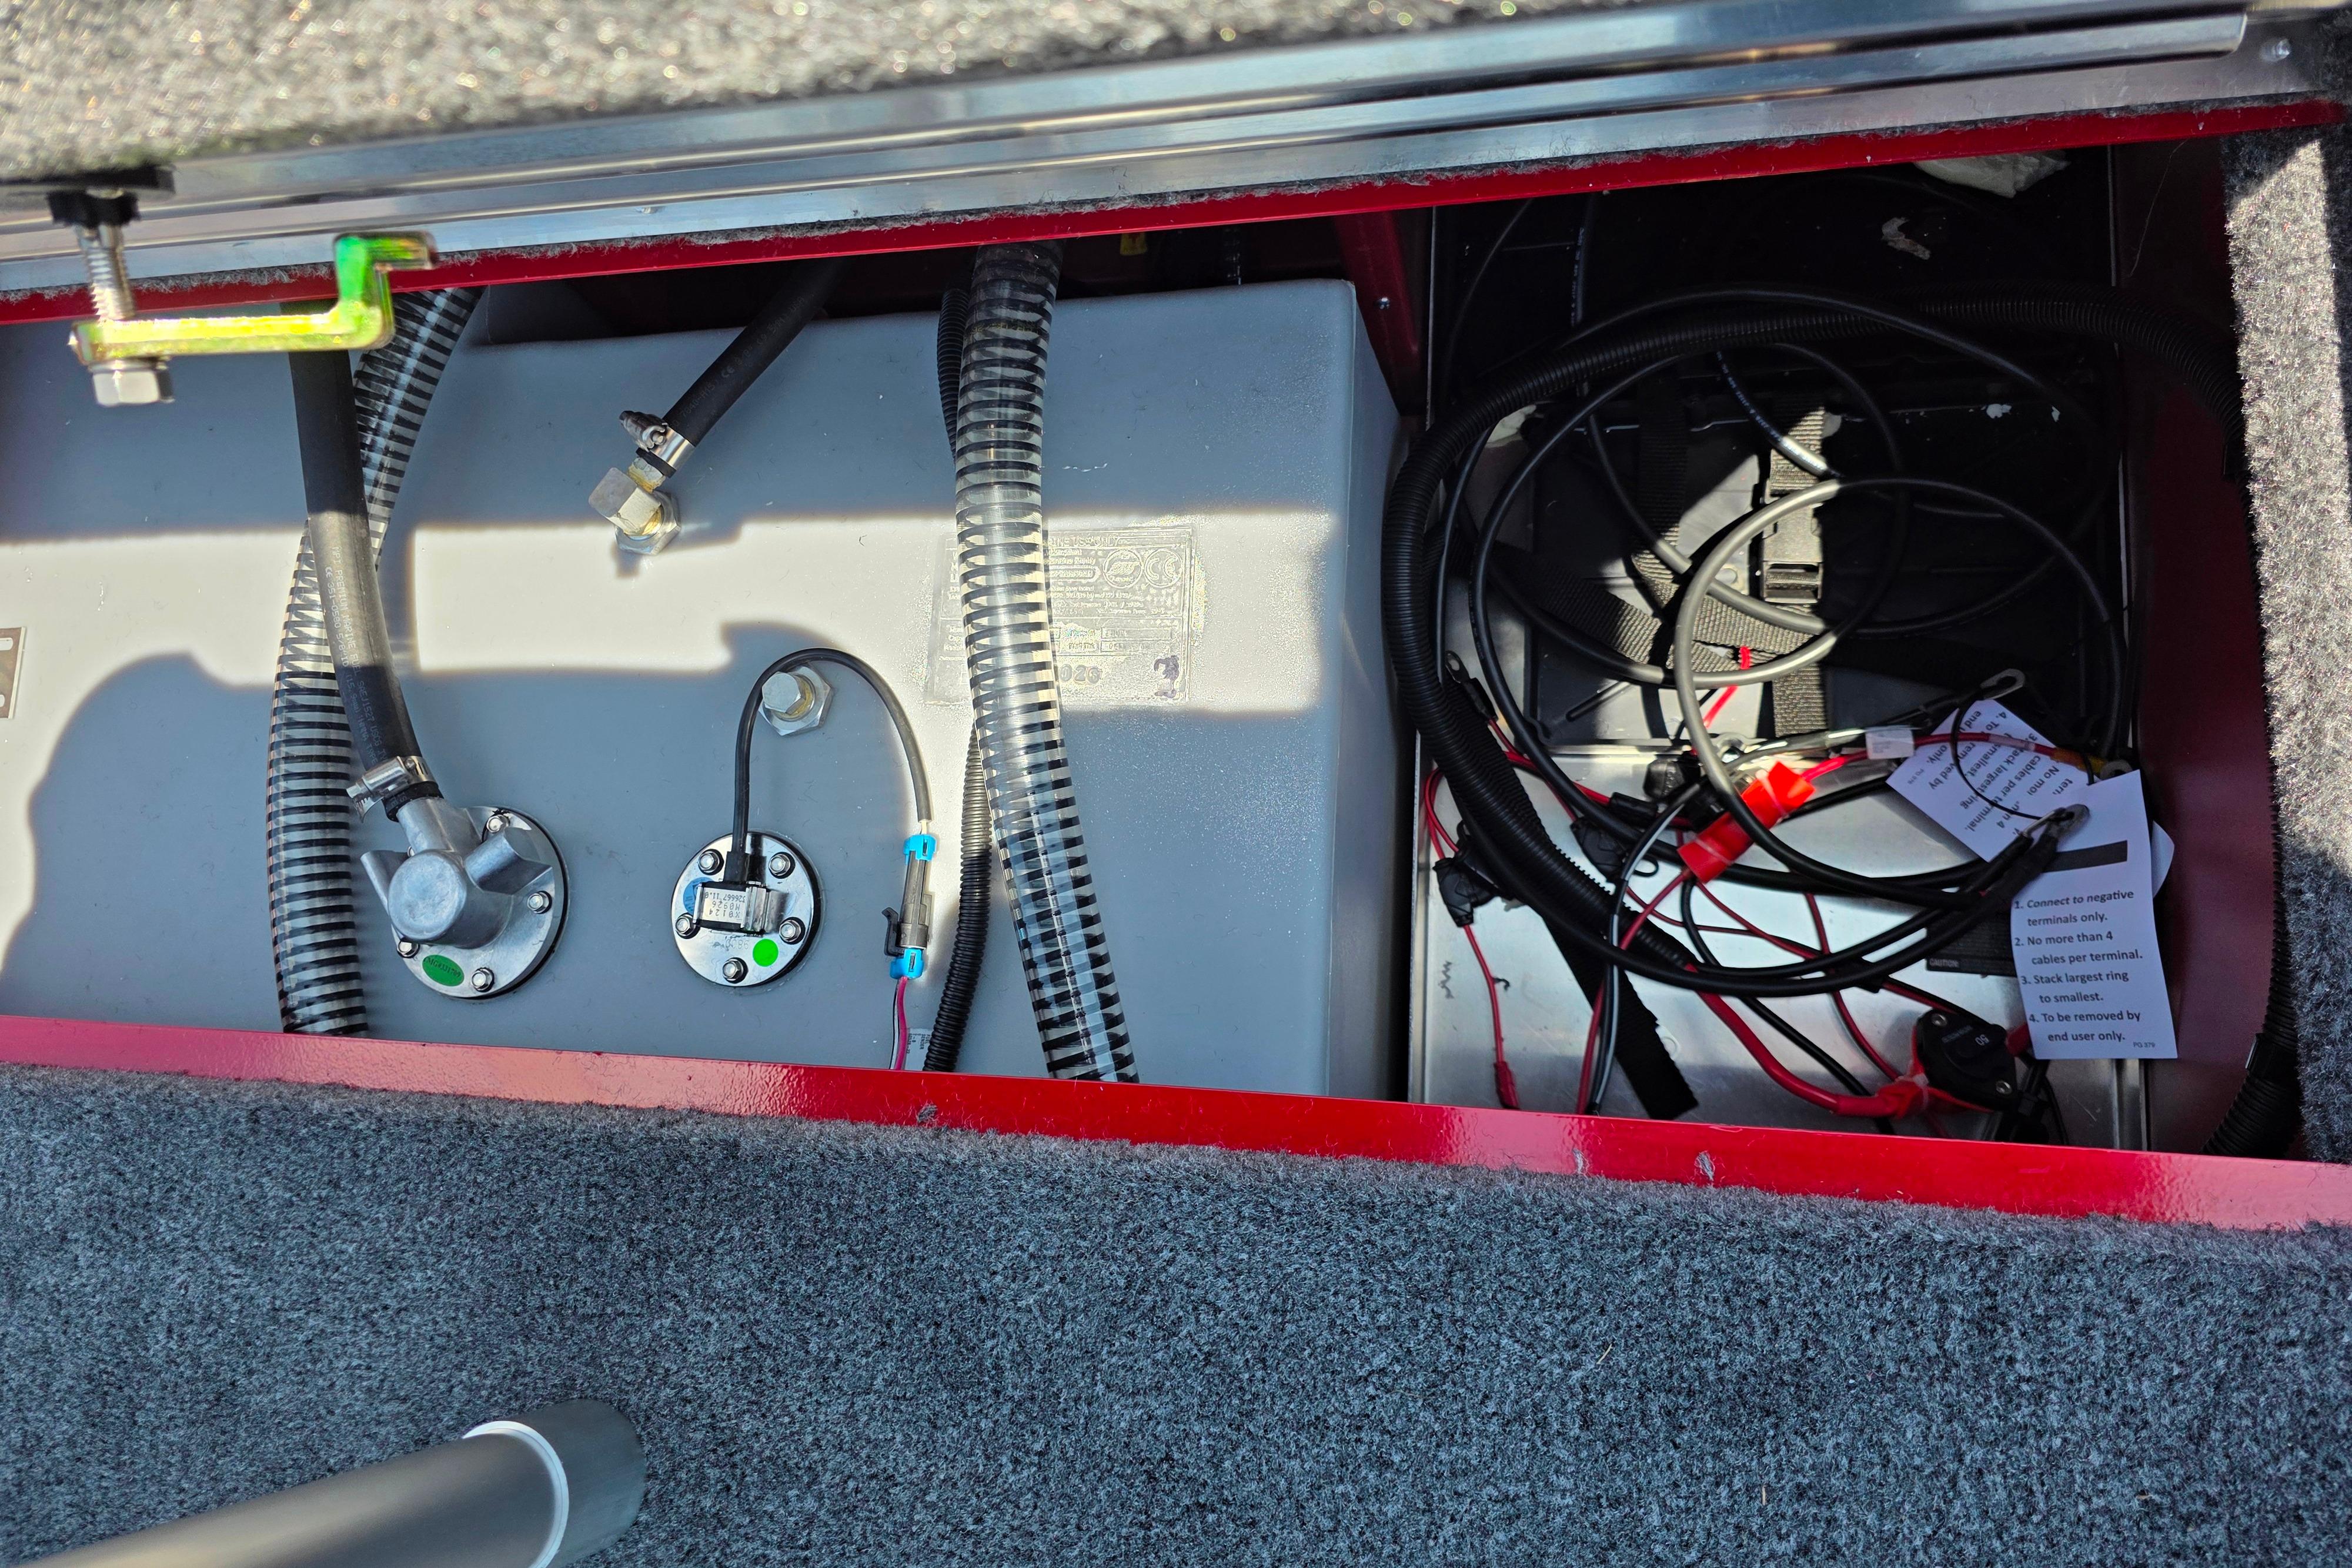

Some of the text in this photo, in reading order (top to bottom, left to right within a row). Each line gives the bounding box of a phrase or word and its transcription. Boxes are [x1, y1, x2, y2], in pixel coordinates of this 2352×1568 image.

[331, 546, 340, 564] MPI
[335, 569, 348, 610] PREMIUM
[327, 581, 341, 628] 351-0580
[342, 614, 356, 649] MARINE
[349, 653, 363, 676] FUEL
[358, 680, 375, 722] SAEJ1527
[1995, 710, 2007, 720] 4.
[1985, 720, 1999, 733] To
[1926, 710, 1982, 764] end only.
[2014, 754, 2041, 783] cables
[2043, 766, 2059, 780] No
[1927, 777, 1942, 791] by
[1977, 761, 2007, 793] largest
[1999, 779, 2015, 798] per
[1996, 820, 2004, 828] 4
[2014, 890, 2134, 909] 1. Connect to negative
[2027, 911, 2107, 926] terminals only.
[2014, 931, 2113, 946] 2. No more than 4
[2032, 950, 2143, 965] cables per terminal.
[2021, 971, 2129, 984] 3. Stack largest ring
[2039, 993, 2103, 1003] to smallest.
[2029, 1010, 2140, 1022] 4. To be removed by
[2048, 1031, 2125, 1042] end user only.
